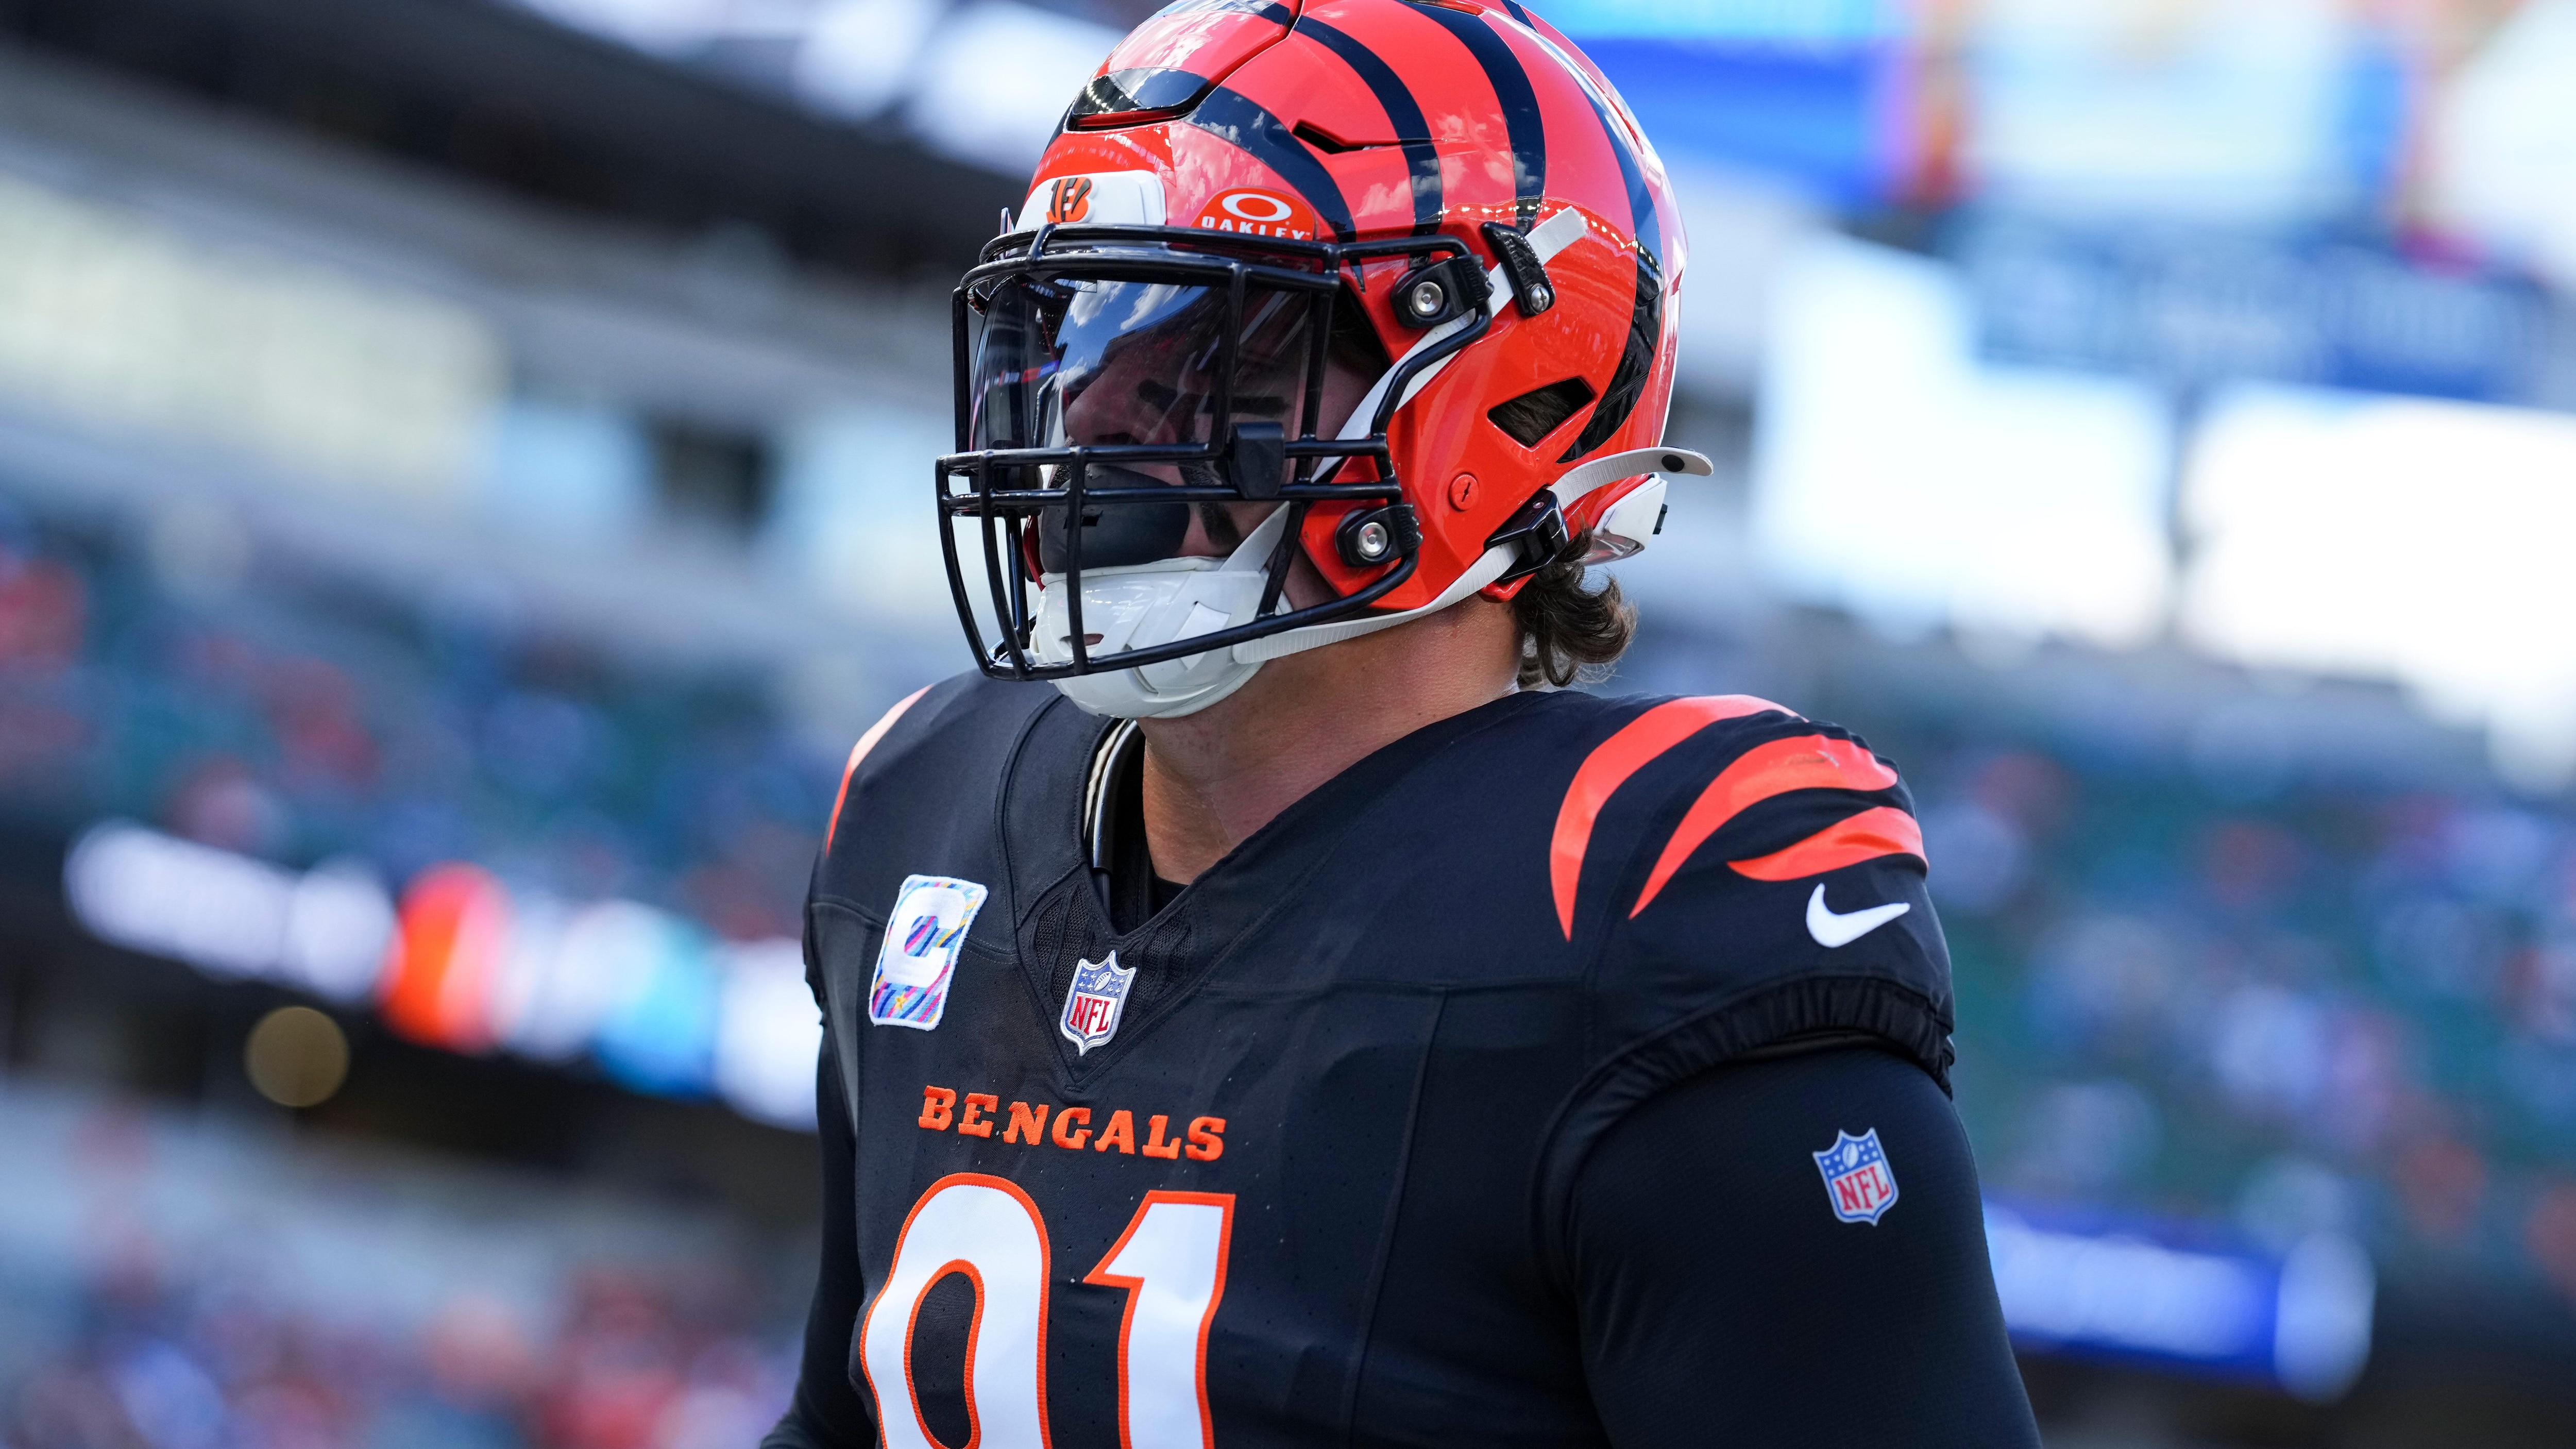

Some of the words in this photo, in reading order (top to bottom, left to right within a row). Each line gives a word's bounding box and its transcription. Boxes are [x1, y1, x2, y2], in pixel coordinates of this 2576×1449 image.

[1201, 216, 1306, 240] OAKLEY
[1071, 995, 1111, 1035] NFL
[918, 1085, 1227, 1161] BENGALS
[1835, 1166, 1890, 1211] NFL
